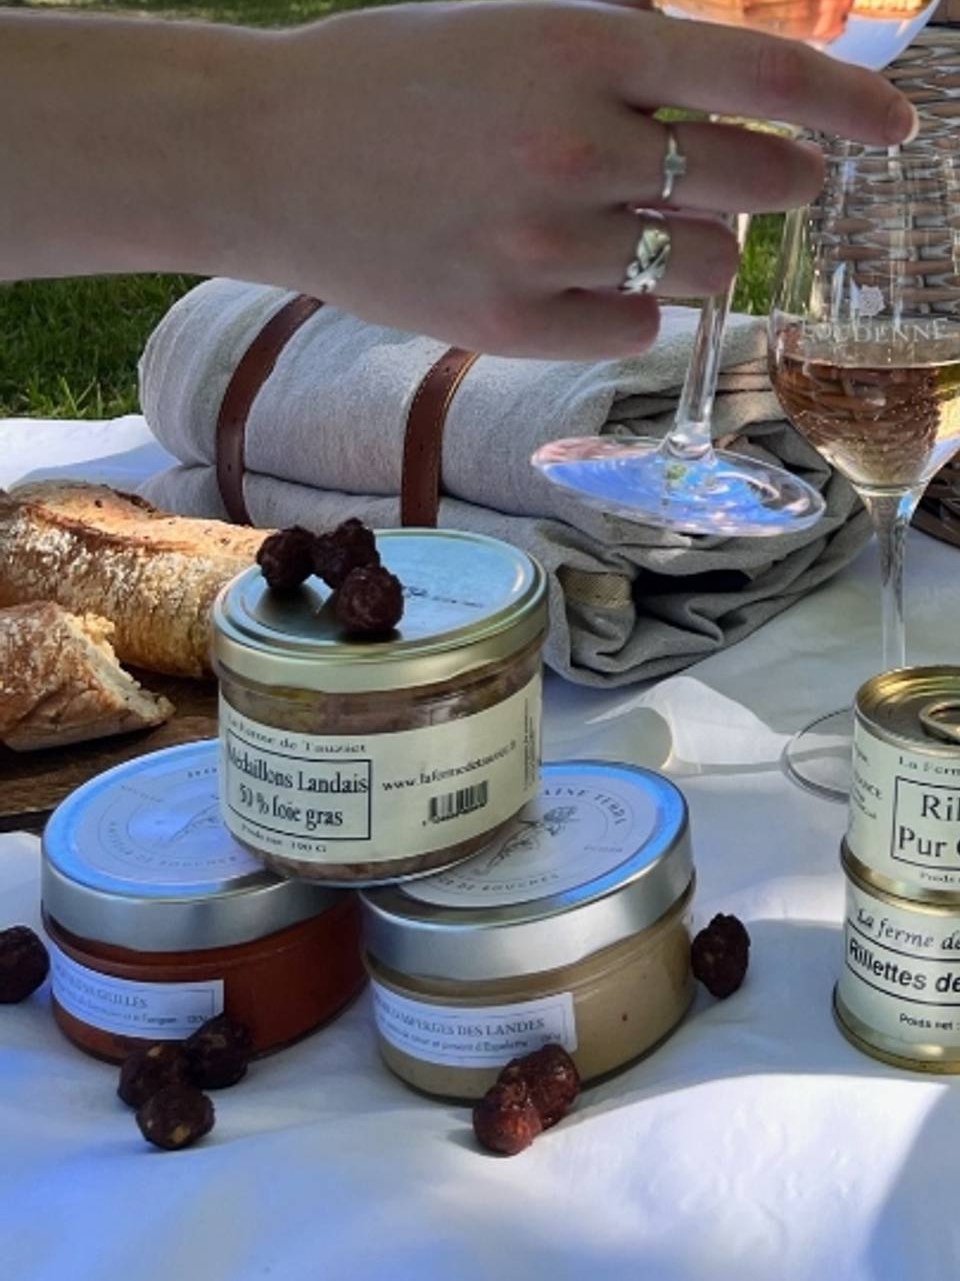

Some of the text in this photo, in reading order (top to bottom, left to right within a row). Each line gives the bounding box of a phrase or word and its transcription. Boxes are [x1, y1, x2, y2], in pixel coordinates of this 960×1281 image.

[297, 771, 369, 794] Landais
[272, 794, 302, 822] foie
[305, 809, 344, 832] gras
[898, 825, 948, 859] Pur
[874, 917, 936, 948] ferme
[848, 937, 928, 991] Rillettes
[485, 1017, 545, 1037] LANDES
